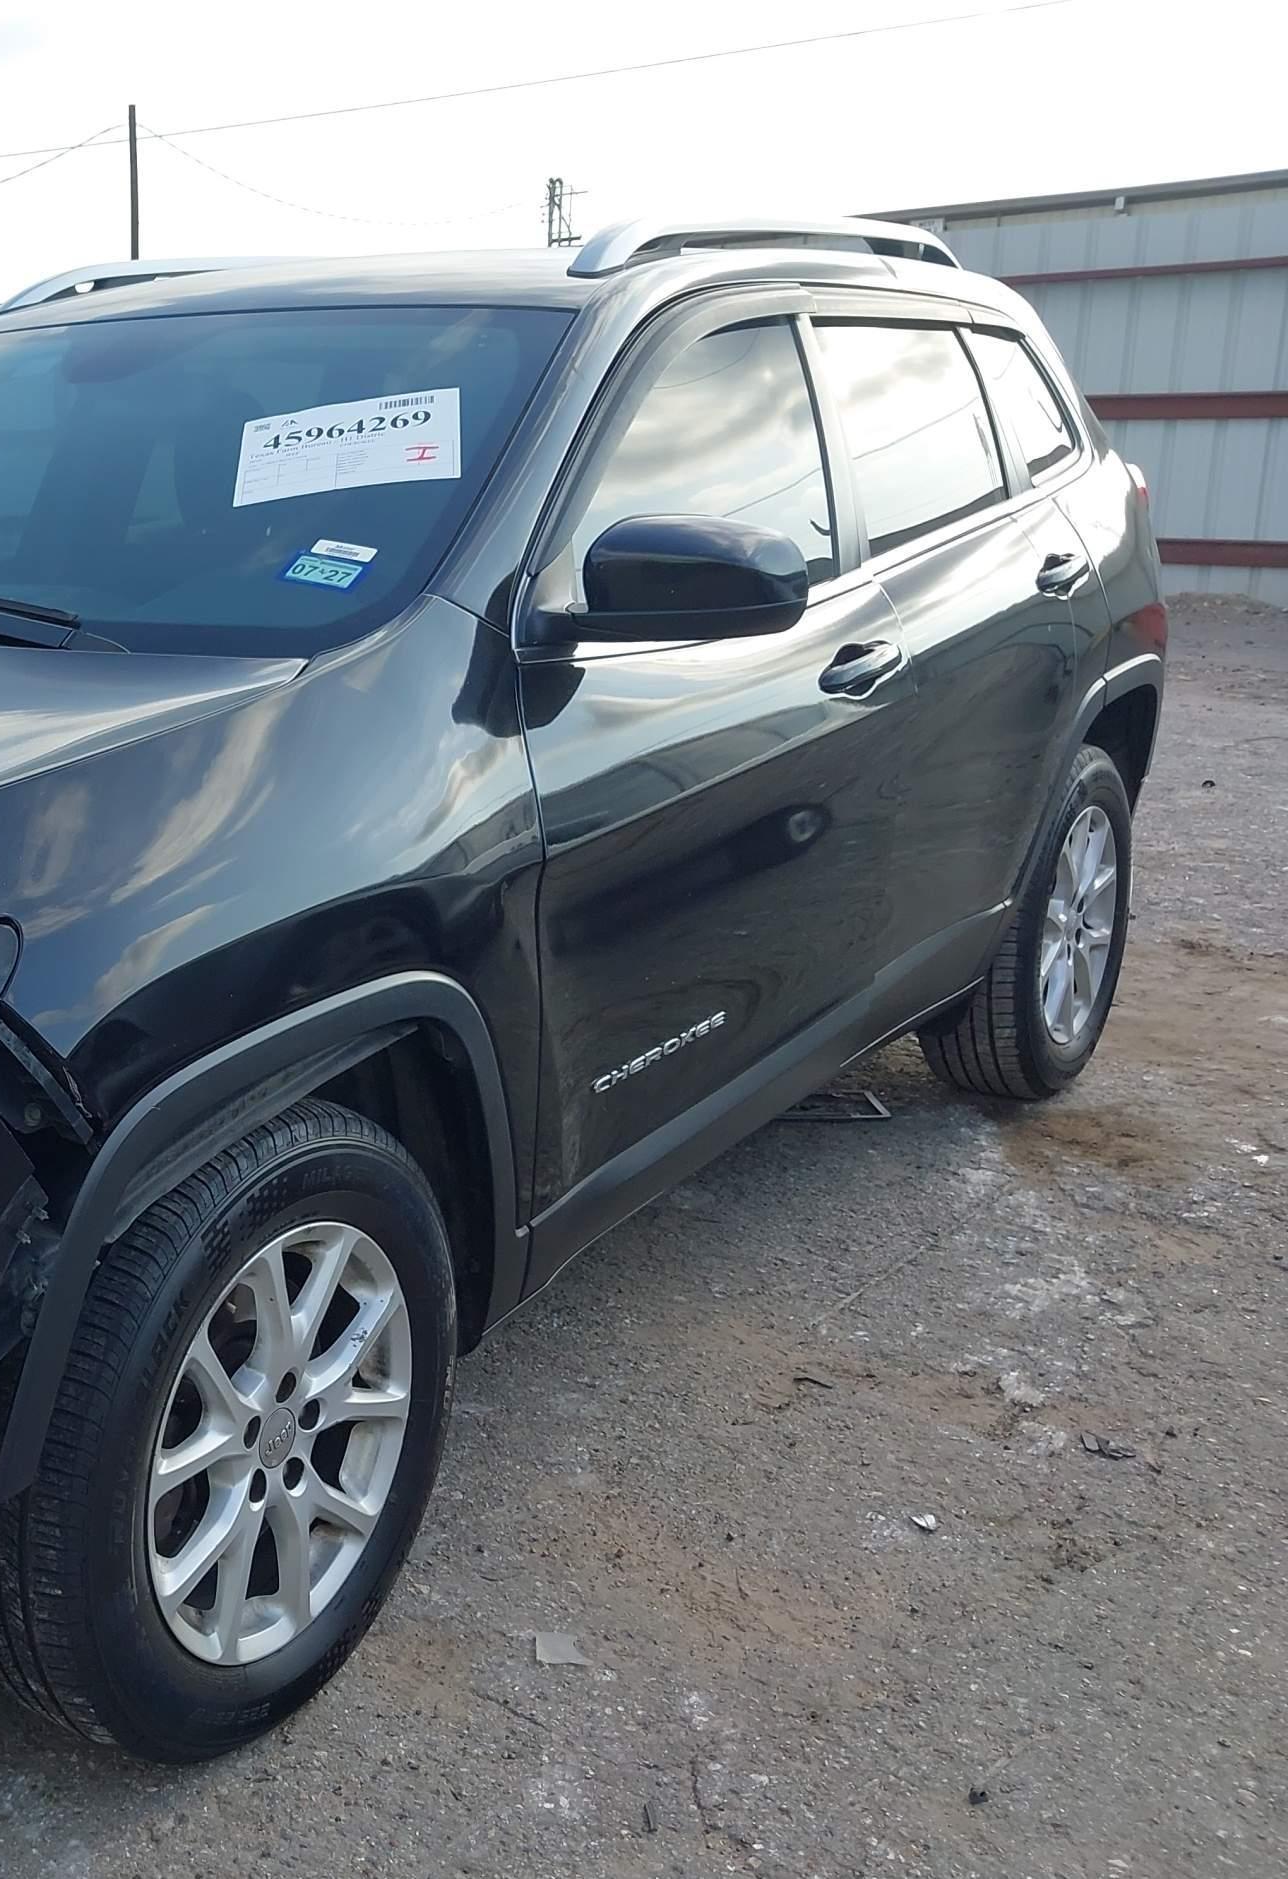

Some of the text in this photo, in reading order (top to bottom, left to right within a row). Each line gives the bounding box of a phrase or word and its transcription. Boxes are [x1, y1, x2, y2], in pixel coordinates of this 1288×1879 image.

[263, 410, 432, 449] 45964269
[292, 563, 353, 583] 07 27
[592, 1011, 727, 1093] CHEROKEE
